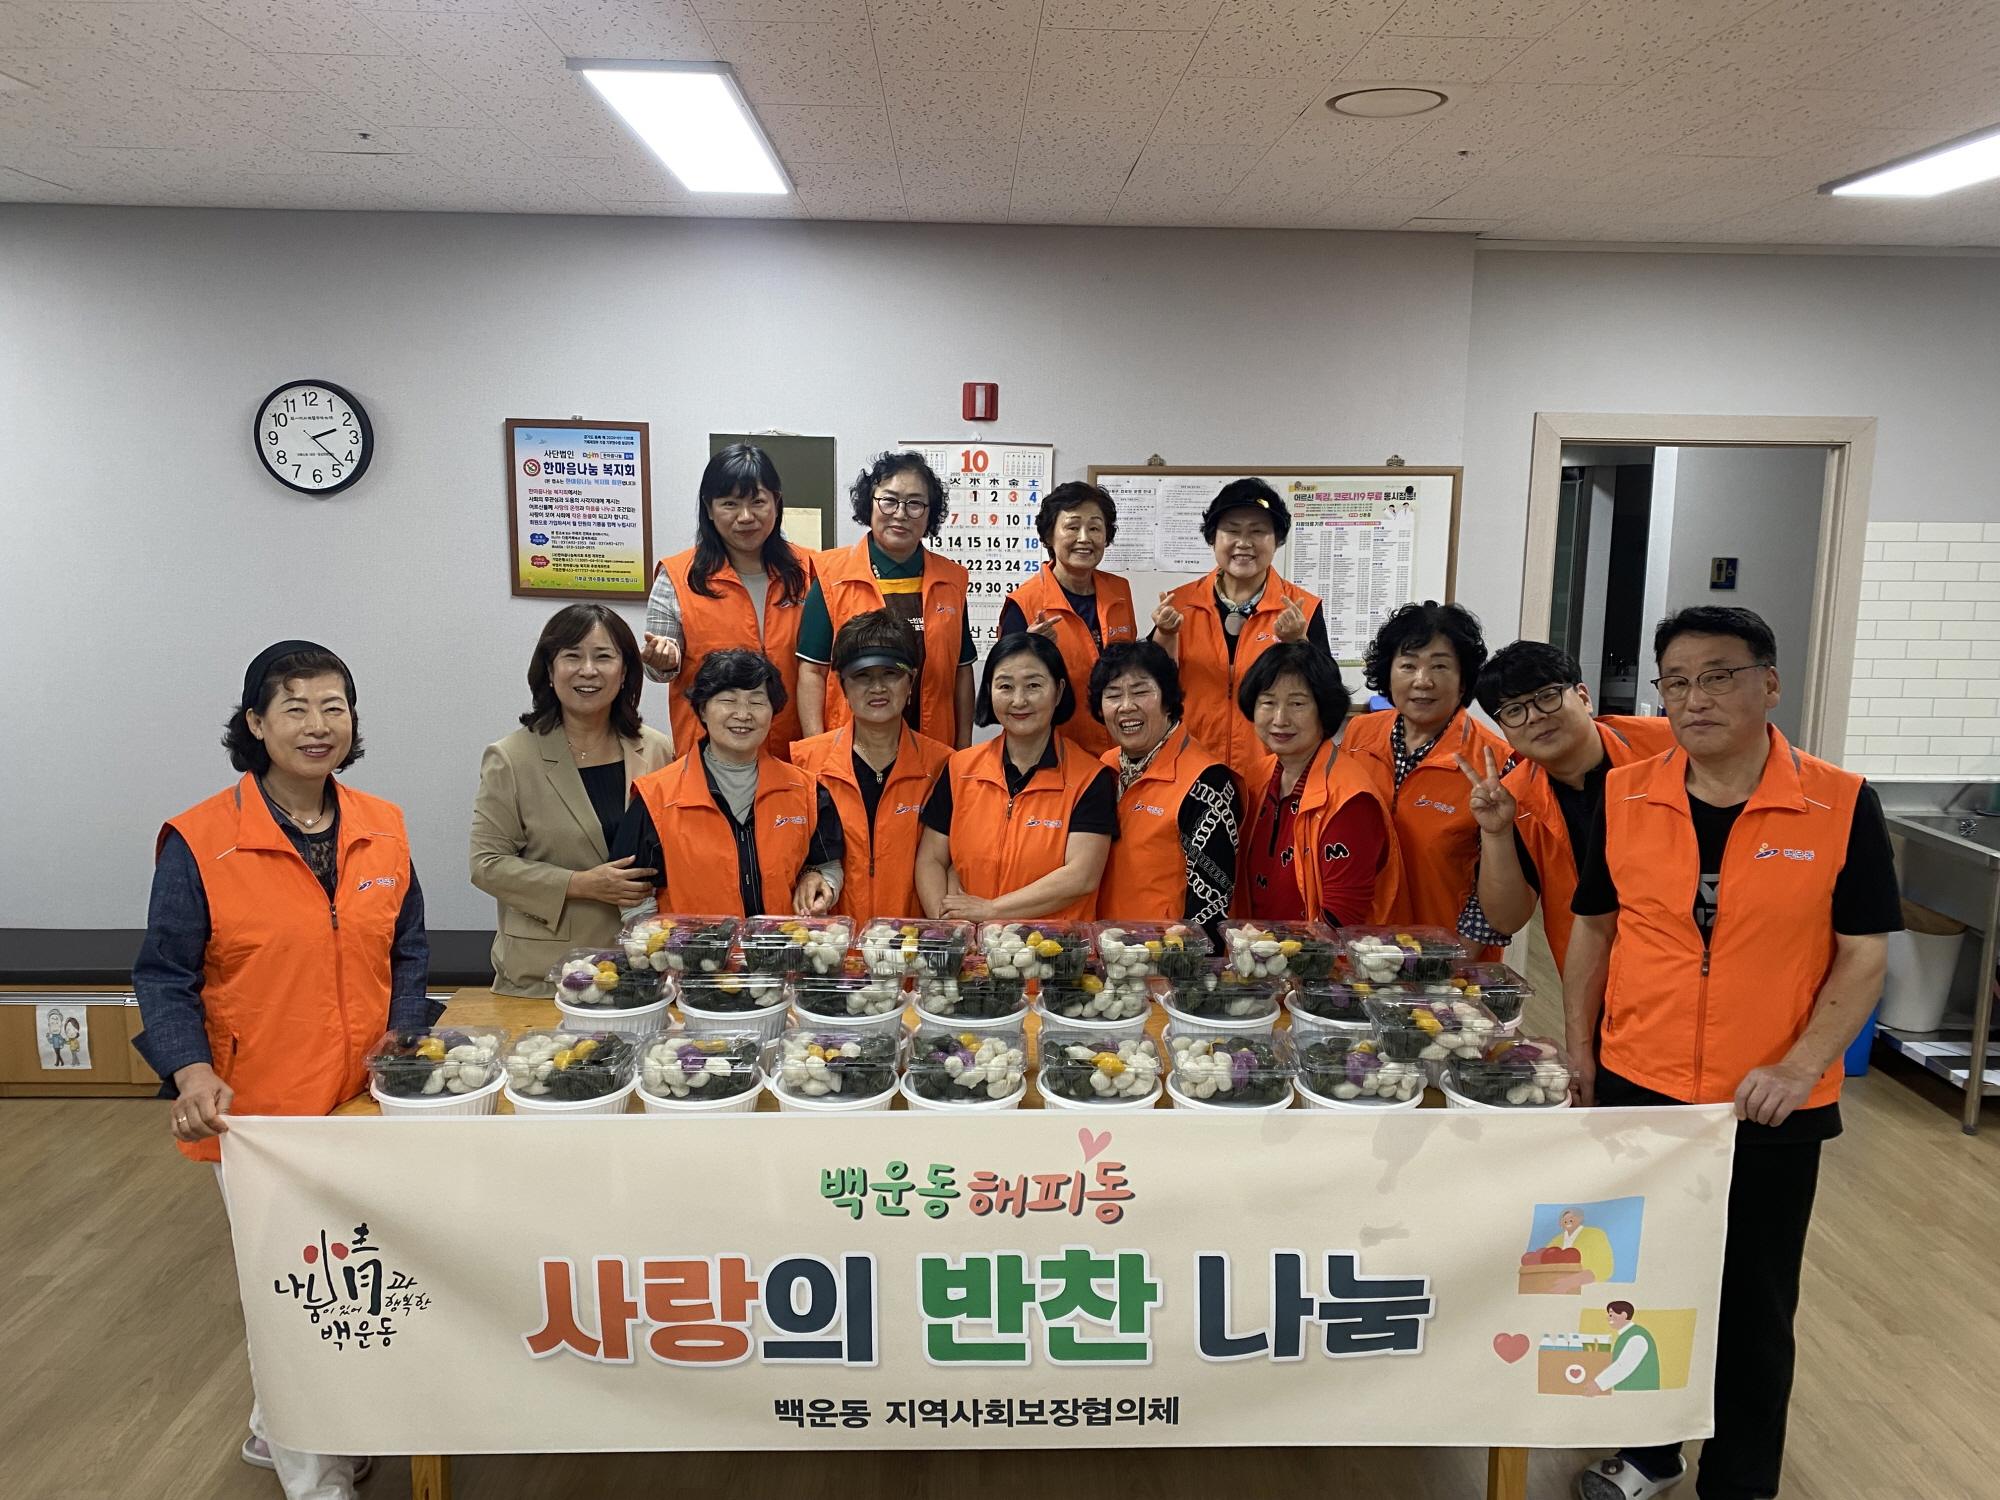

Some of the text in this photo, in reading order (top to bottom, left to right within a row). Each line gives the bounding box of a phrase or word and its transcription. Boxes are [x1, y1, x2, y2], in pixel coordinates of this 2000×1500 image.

[283, 399, 295, 412] 11
[302, 392, 318, 406] 12
[327, 398, 333, 412] 1
[272, 413, 288, 427] 10
[342, 412, 352, 426] 2
[268, 431, 278, 445] 9
[349, 430, 359, 444] 3
[277, 450, 287, 464] 8
[345, 450, 355, 463] 4
[544, 450, 574, 459] 사단법인
[961, 450, 989, 473] 10
[292, 464, 301, 478] 7
[313, 469, 322, 483] 6
[332, 464, 341, 478] 5
[543, 461, 635, 477] 한마음나눔 복지회
[1028, 479, 1039, 487] 土
[972, 491, 978, 502] 1
[990, 491, 998, 502] 2
[1009, 491, 1018, 502] 3
[1029, 492, 1037, 503] 4
[1334, 493, 1365, 501] 코로나19
[1367, 492, 1382, 500] 무료
[951, 513, 959, 525] 7
[971, 514, 978, 525] 8
[989, 514, 998, 525] 9
[1007, 514, 1020, 526] 10
[929, 536, 1039, 549] 13 14 15 16 17 18
[967, 559, 982, 571] 22
[986, 560, 1001, 571] 23
[1005, 560, 1020, 571] 24
[1024, 561, 1039, 572] 25
[967, 582, 1019, 593] 29 30 31
[1783, 848, 1815, 861] 백운동
[820, 1161, 1135, 1225] 백운동 해피동
[385, 1292, 431, 1316] 행복한
[525, 1249, 1431, 1362] 사랑의 반찬 나눔
[321, 1317, 397, 1351] 백운동
[775, 1396, 1180, 1429] 백운동 지역사회보장협의체
